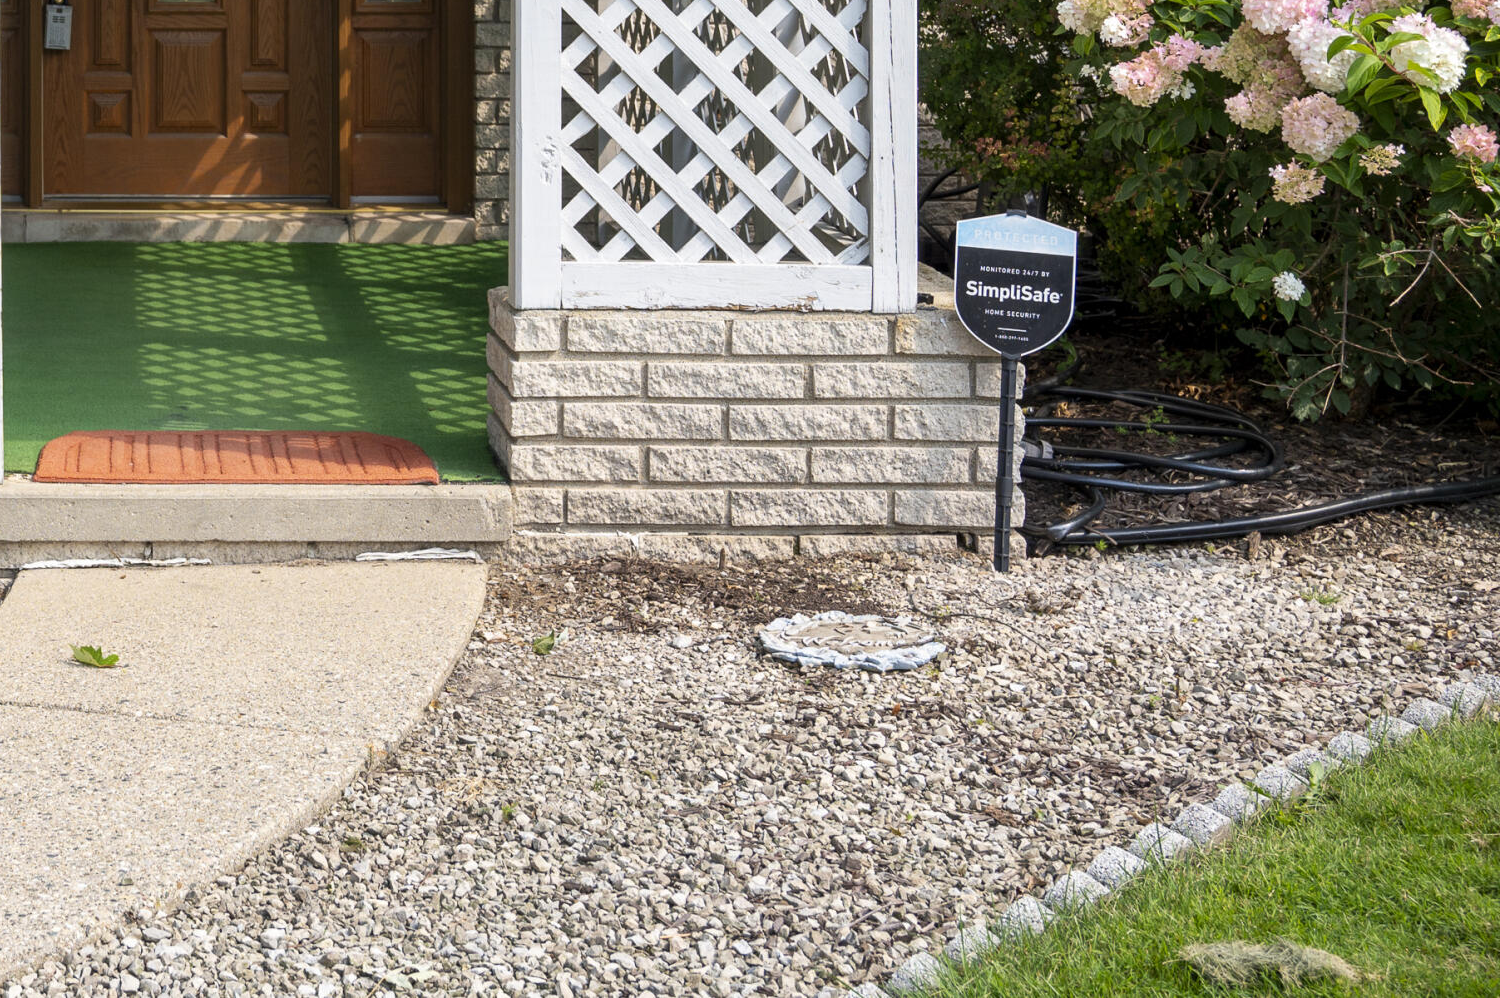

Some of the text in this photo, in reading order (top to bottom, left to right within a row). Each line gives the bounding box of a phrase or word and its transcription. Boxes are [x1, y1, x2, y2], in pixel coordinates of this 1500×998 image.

[974, 229, 1058, 245] PROTECTED
[980, 266, 1020, 275] MONITORED
[966, 281, 1060, 303] SimpliSafe
[985, 308, 1041, 319] HOME SECURITY
